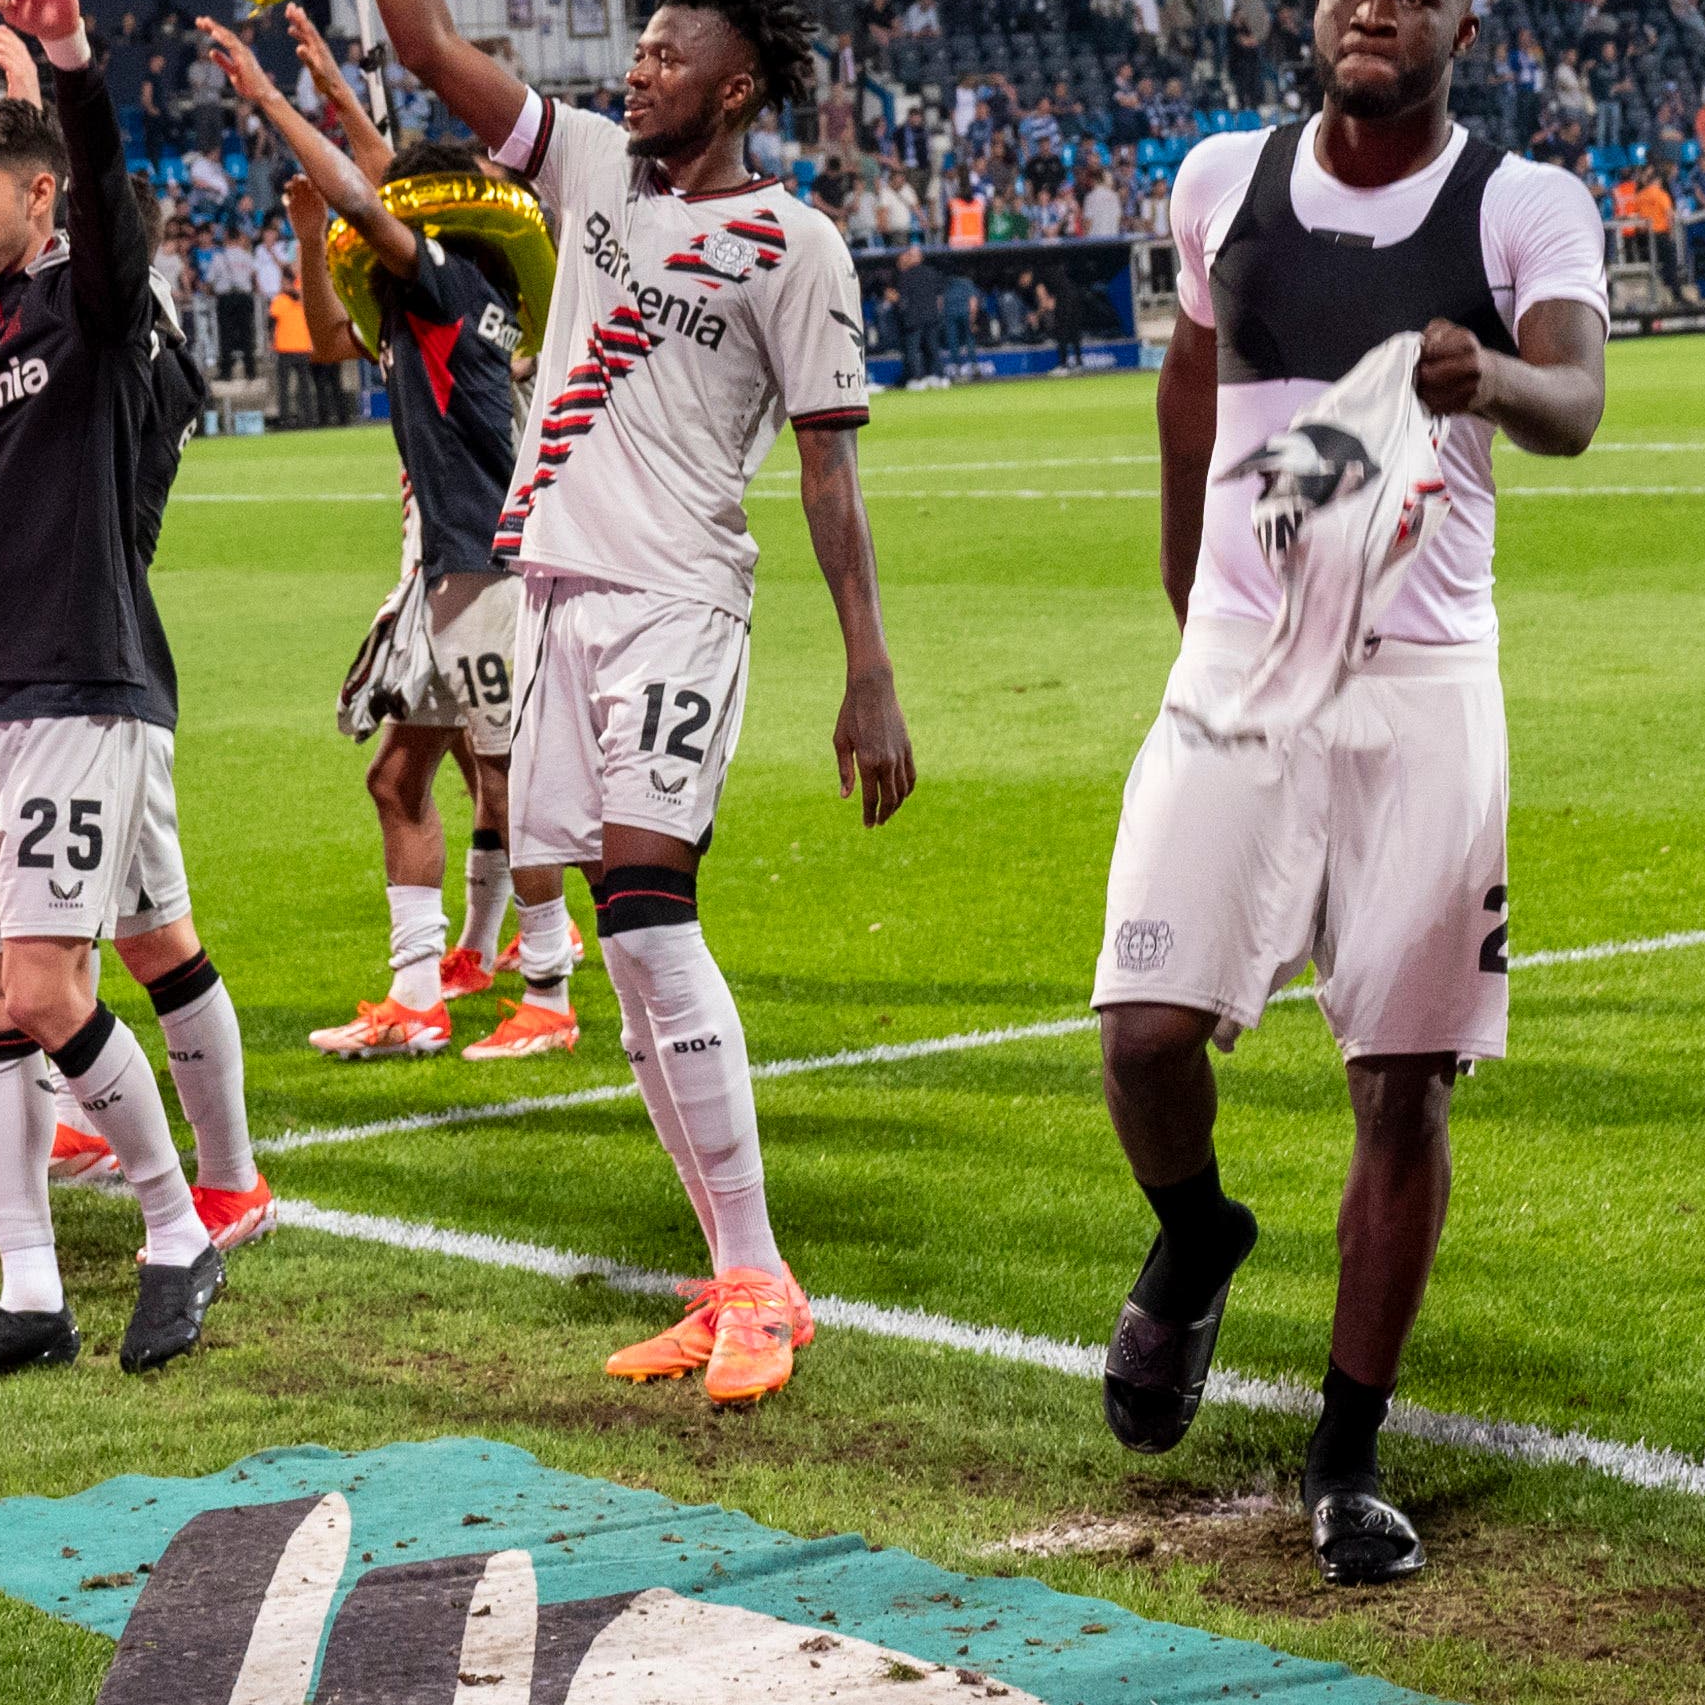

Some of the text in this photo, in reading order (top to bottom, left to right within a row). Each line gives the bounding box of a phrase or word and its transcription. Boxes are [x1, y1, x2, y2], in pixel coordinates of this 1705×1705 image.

[457, 652, 510, 708] 19
[639, 682, 711, 764] 12
[18, 797, 103, 871] 25
